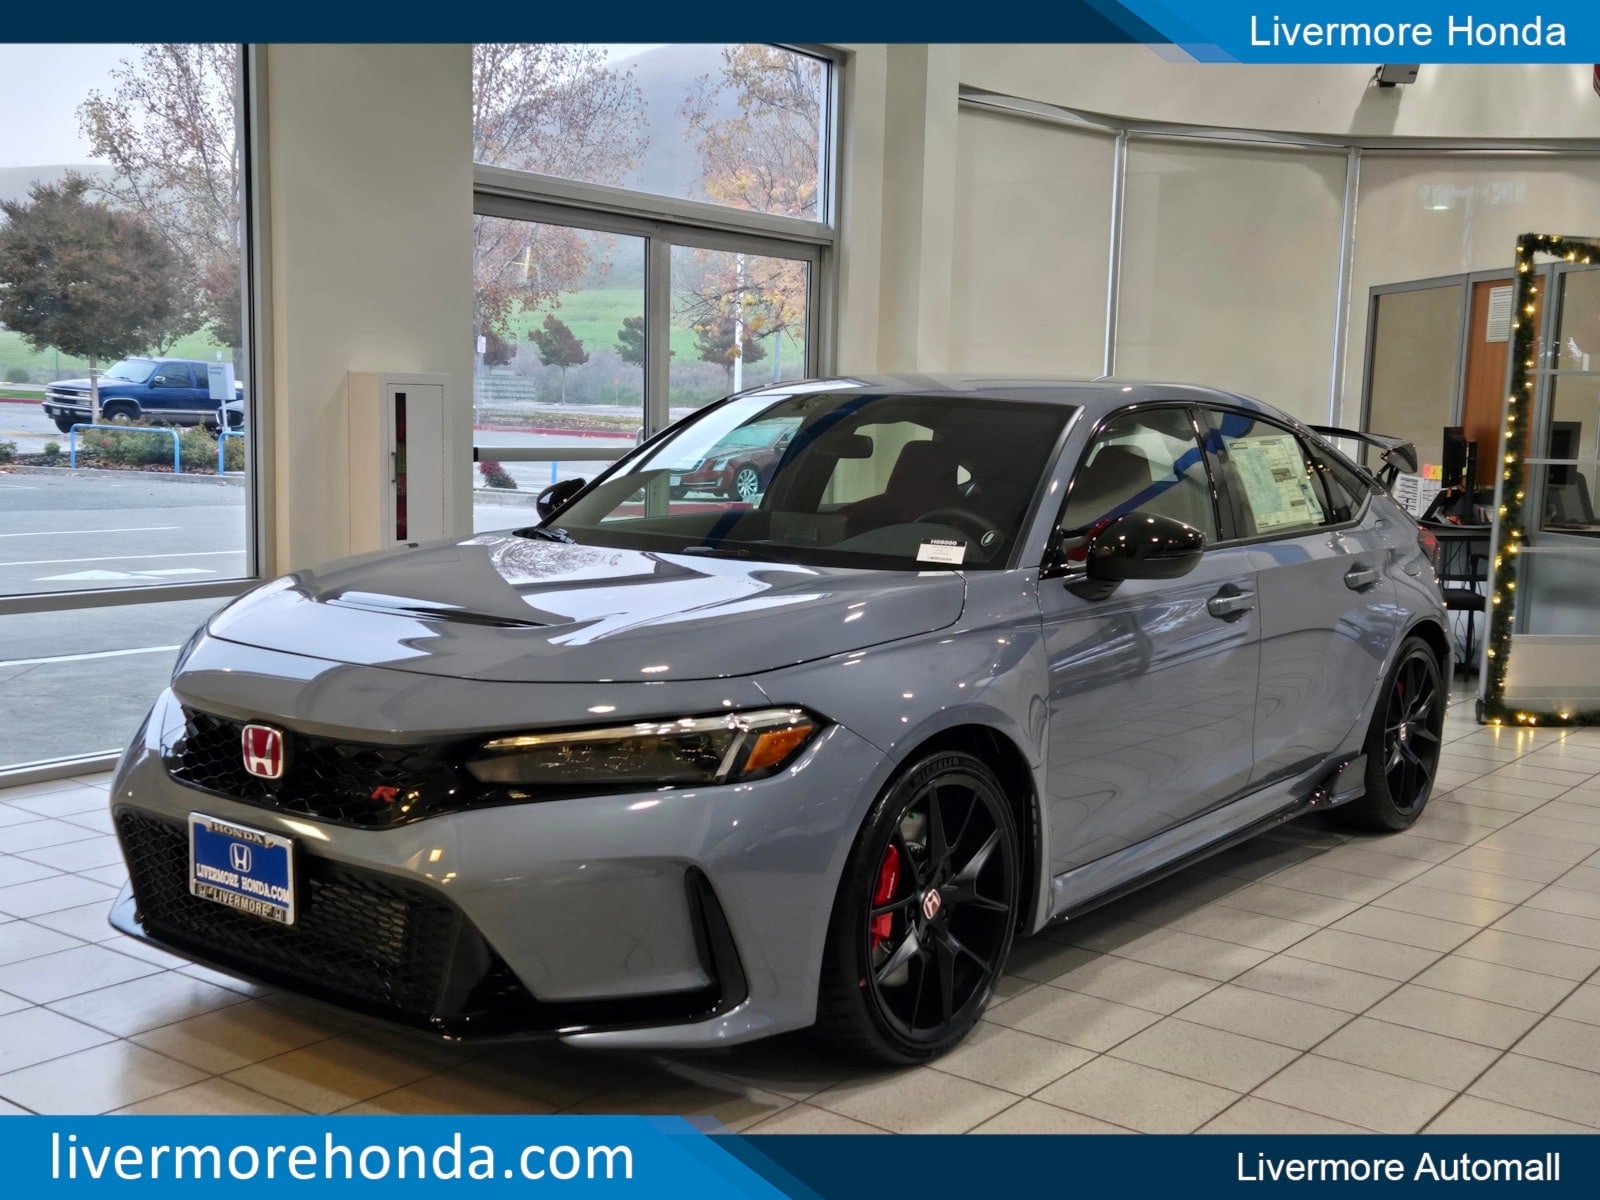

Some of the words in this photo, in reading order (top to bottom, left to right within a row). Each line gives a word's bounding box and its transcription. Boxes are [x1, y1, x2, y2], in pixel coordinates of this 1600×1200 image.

[212, 822, 264, 844] HONDA
[196, 863, 240, 889] LIVERMORE
[241, 876, 290, 903] HONDA.COM
[213, 889, 268, 917] LIVERMORE
